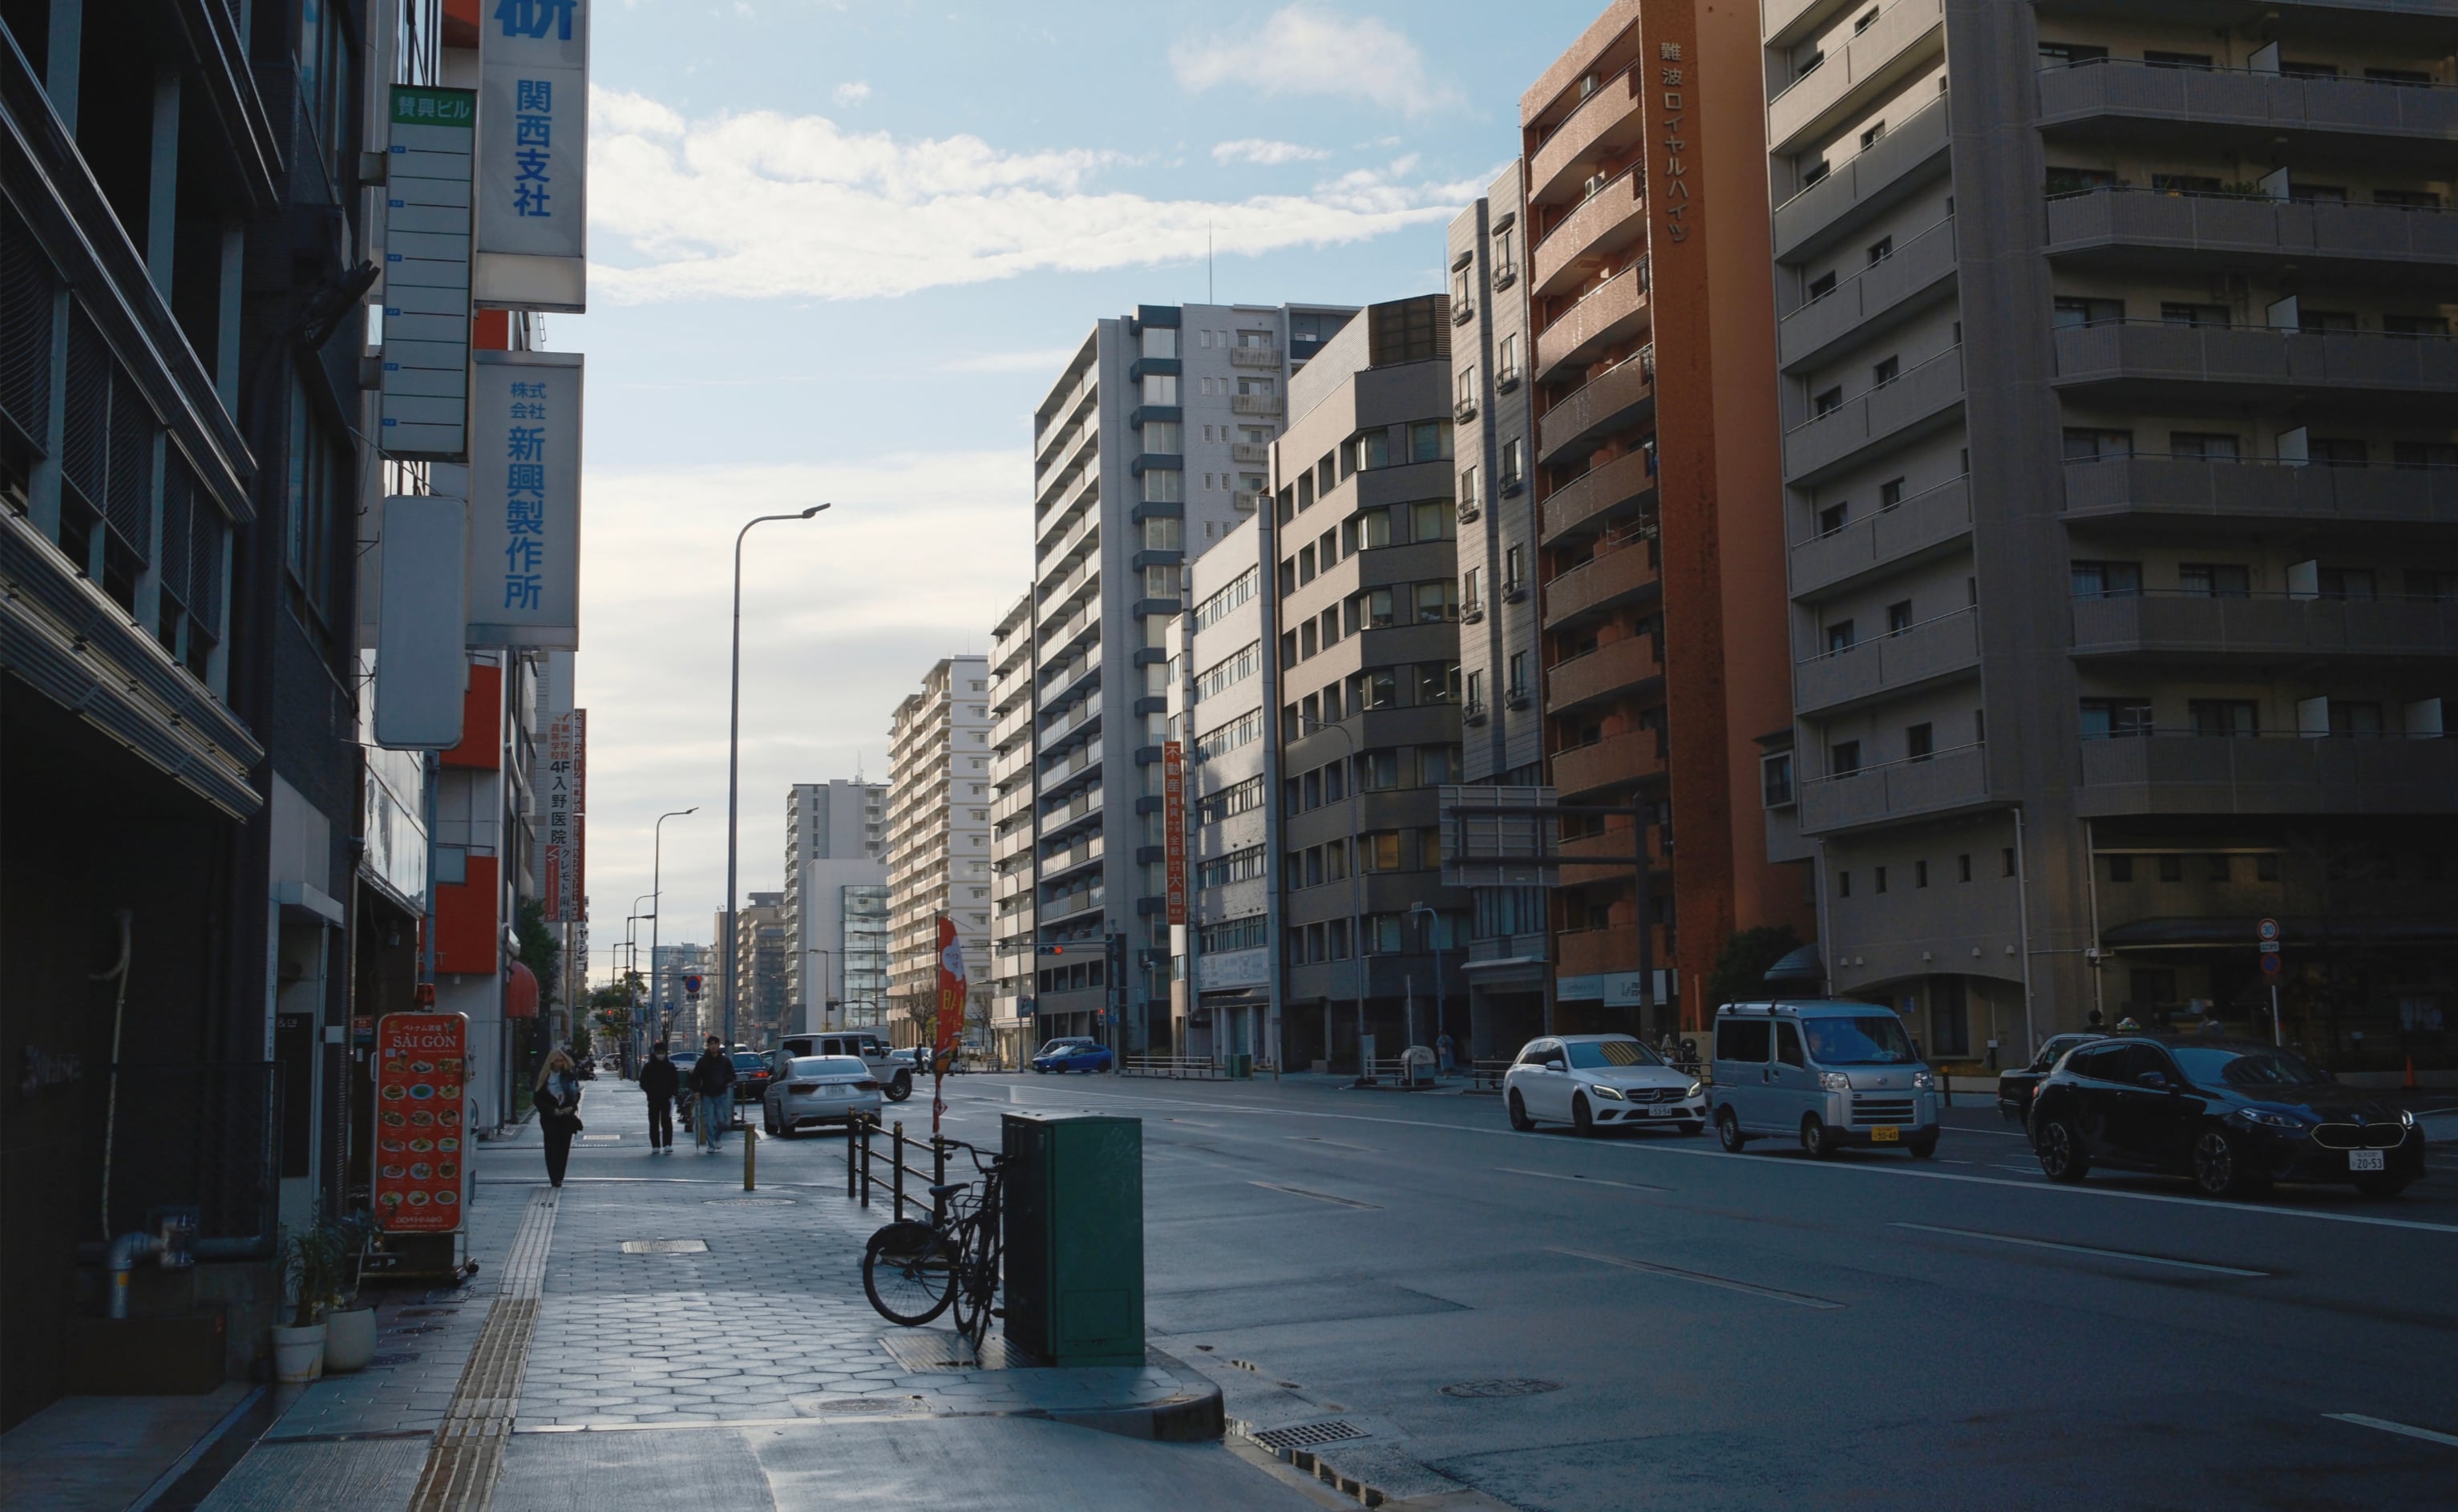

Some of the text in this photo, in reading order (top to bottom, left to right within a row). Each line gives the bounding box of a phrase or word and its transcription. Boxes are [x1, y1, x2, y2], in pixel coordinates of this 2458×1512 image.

[513, 79, 552, 217] 関西支社
[1660, 42, 1689, 241] 難波ロイヤルハイツ
[510, 382, 547, 399] 株式
[510, 402, 546, 420] 会社
[504, 426, 546, 610] 新興製作所
[550, 761, 570, 773] 4F
[1166, 746, 1180, 792] 不動産
[551, 776, 568, 844] 入野医院
[2262, 925, 2274, 935] 30
